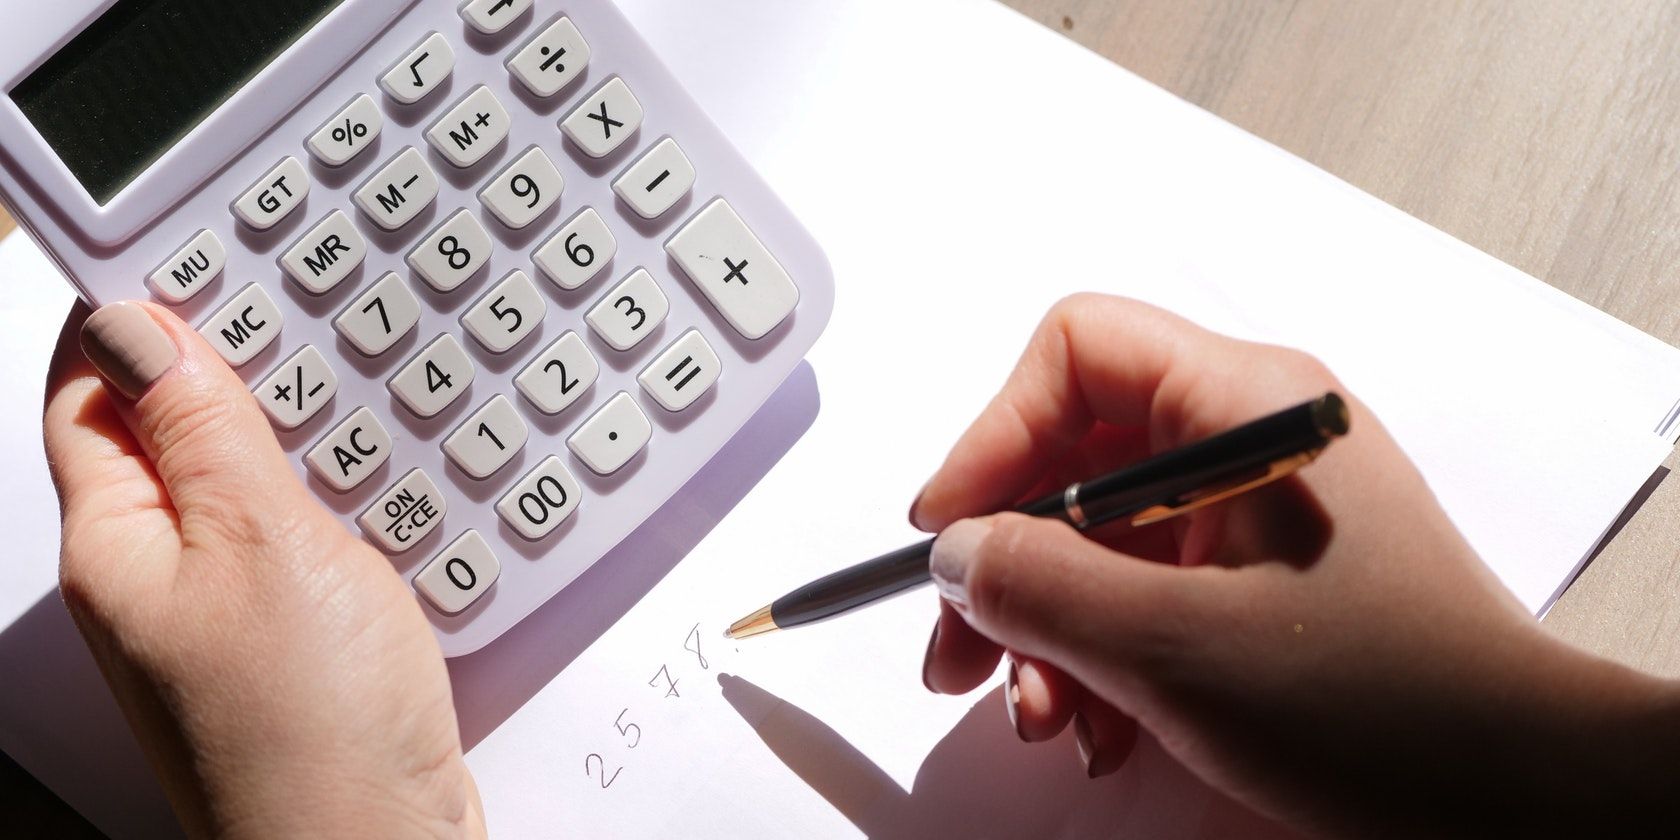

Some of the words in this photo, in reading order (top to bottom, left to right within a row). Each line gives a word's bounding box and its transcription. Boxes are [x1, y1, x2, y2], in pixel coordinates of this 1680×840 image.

[332, 119, 367, 145] %
[449, 113, 490, 150] M+
[258, 176, 292, 213] GT
[511, 174, 540, 208] 9
[303, 235, 350, 276] MR
[438, 236, 470, 269] 8
[565, 233, 594, 267] 6
[171, 250, 209, 288] MU
[221, 306, 266, 349] MC
[362, 297, 391, 334] 7
[489, 296, 522, 333] 5
[614, 296, 645, 330] 3
[426, 360, 452, 393] 4
[544, 360, 579, 394] 2
[333, 427, 377, 476] AC
[478, 423, 505, 450] 1
[385, 488, 415, 518] ON
[519, 476, 566, 524] 00
[446, 558, 476, 590] 0
